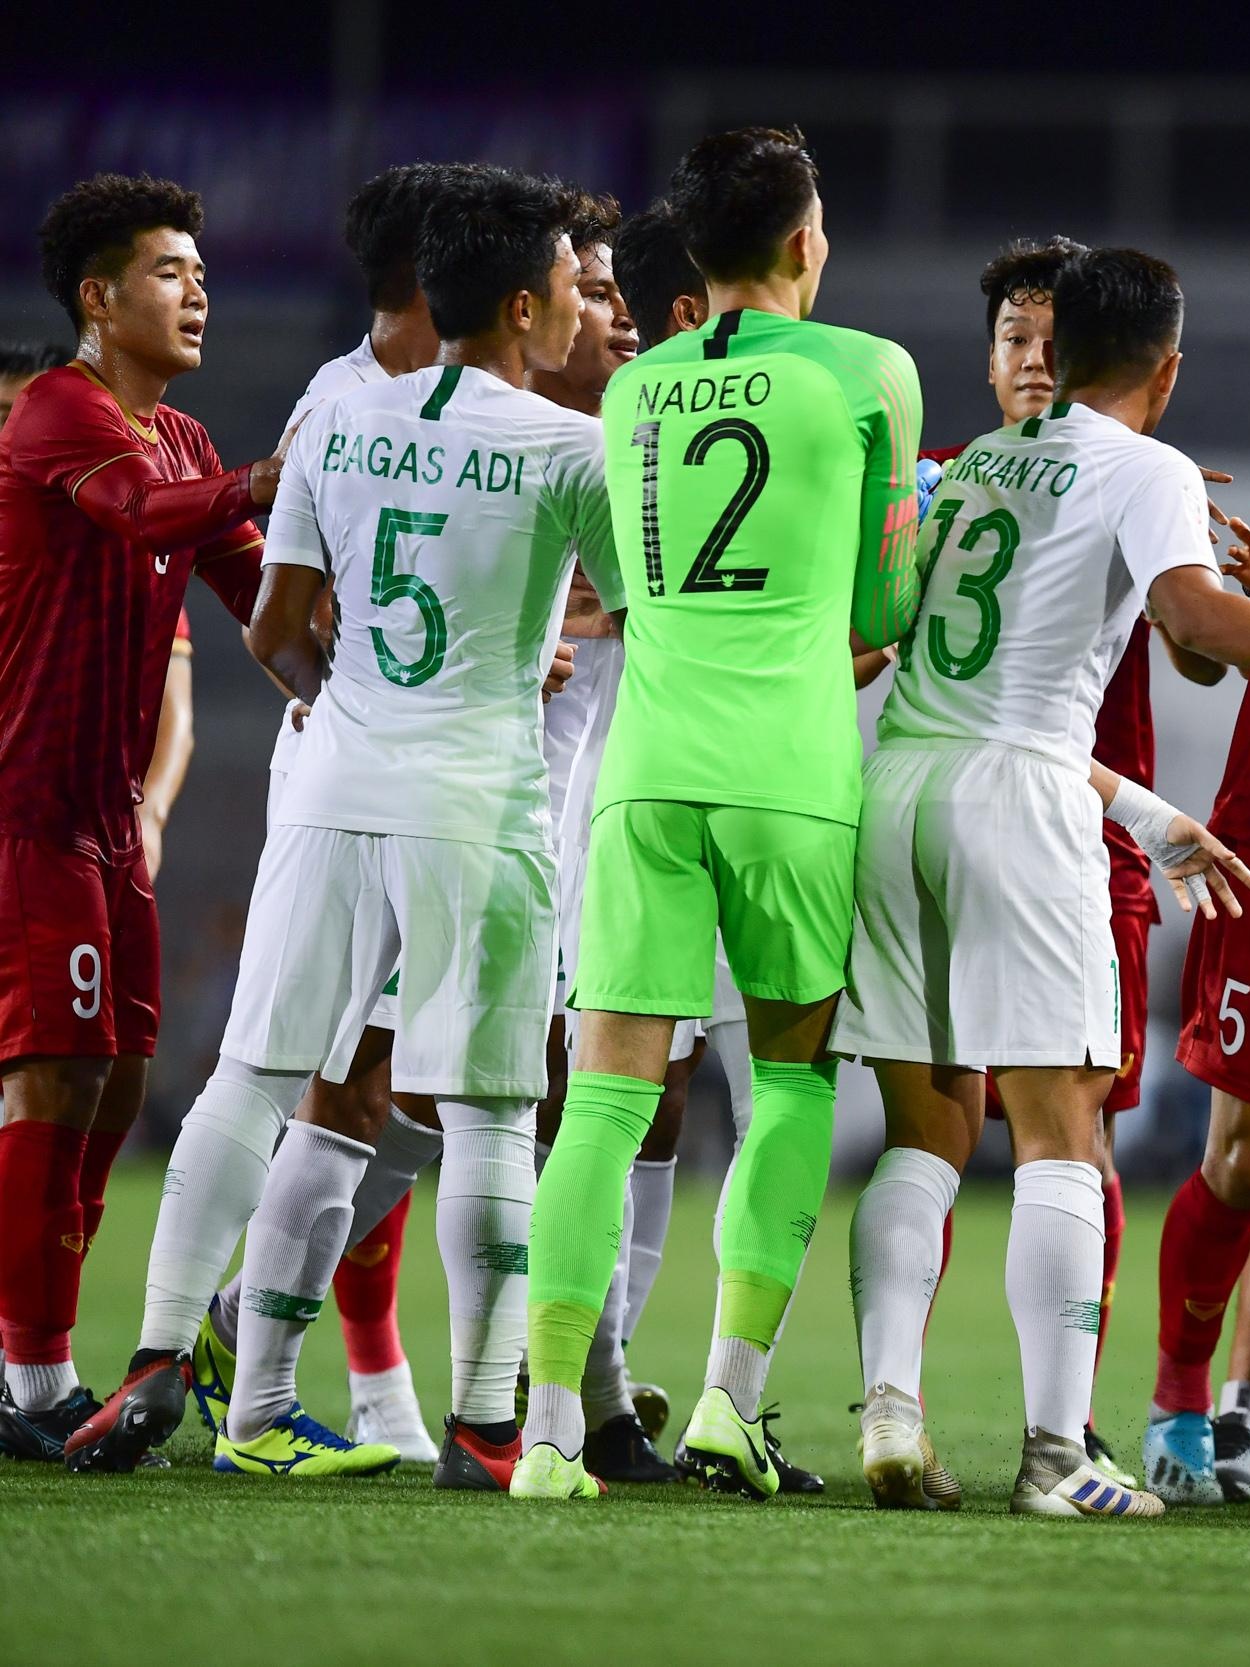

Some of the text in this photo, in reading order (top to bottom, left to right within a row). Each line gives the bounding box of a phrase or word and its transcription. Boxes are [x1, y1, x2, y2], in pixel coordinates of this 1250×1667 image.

[636, 372, 771, 418] NADEO
[323, 433, 524, 495] BAGAS ADI
[630, 417, 770, 597] 12
[367, 507, 449, 688] 5
[898, 499, 1021, 681] 13
[69, 943, 101, 1020] 9
[1218, 977, 1250, 1056] 5
